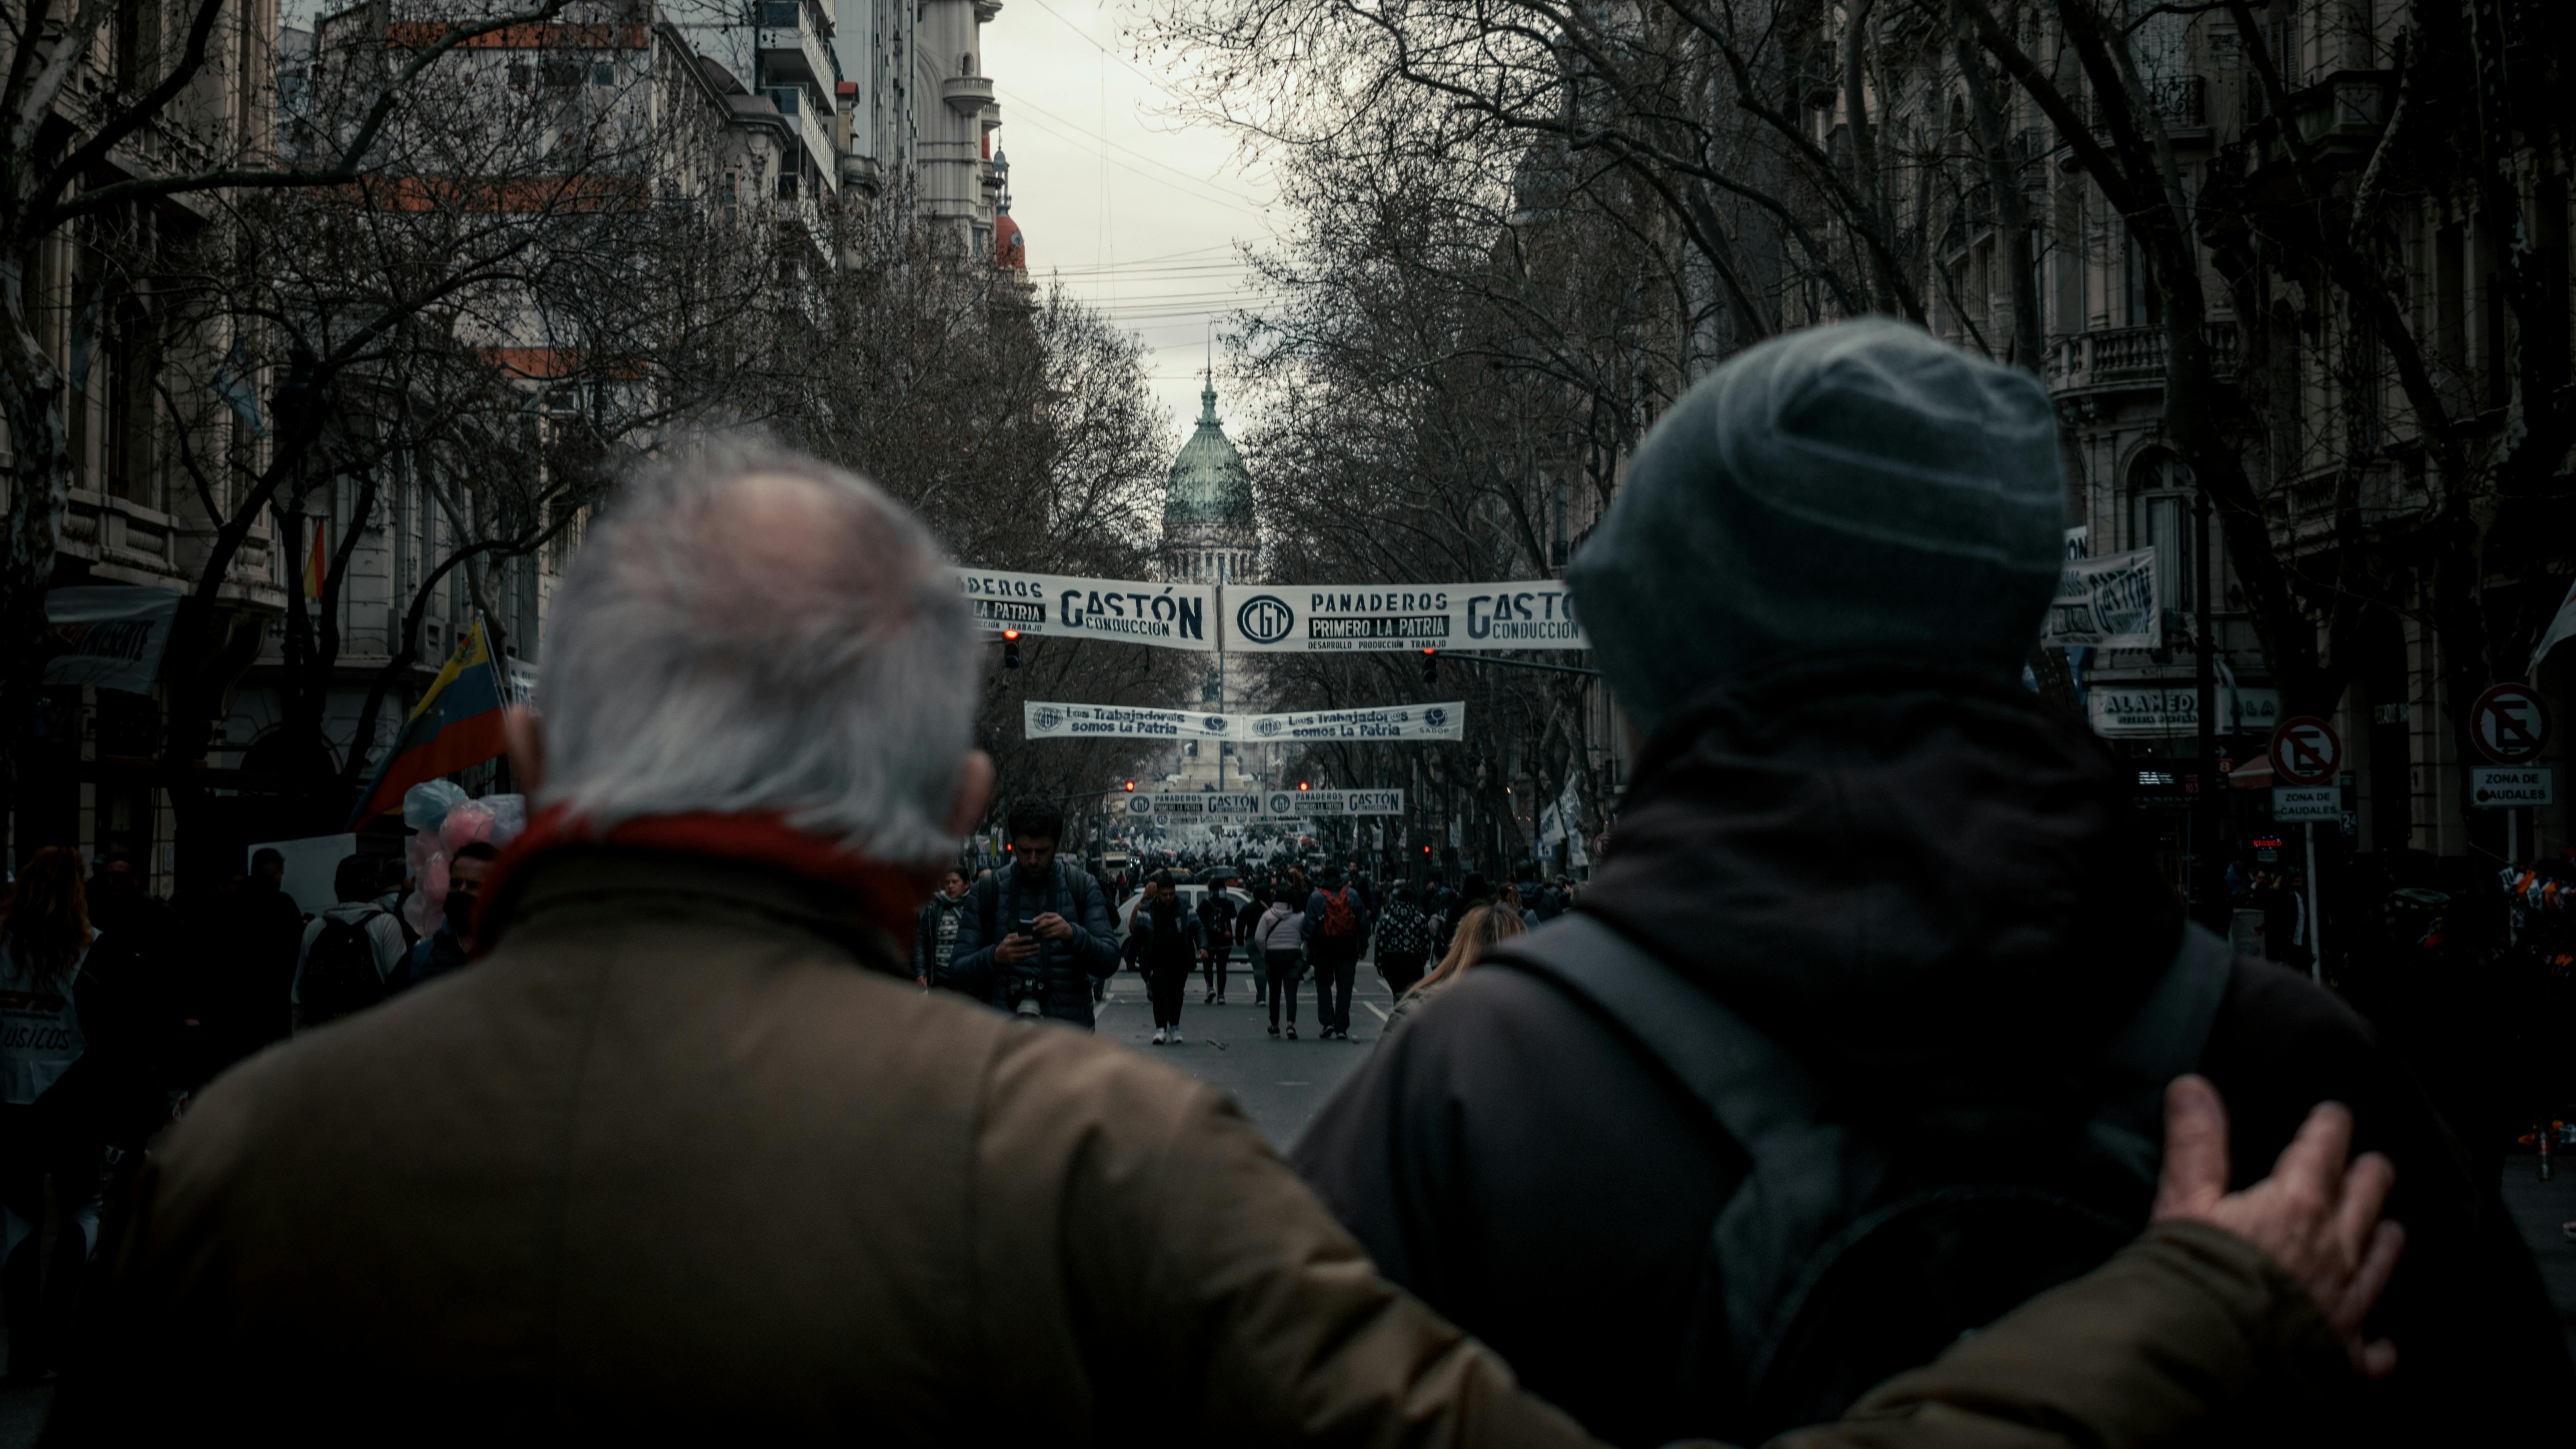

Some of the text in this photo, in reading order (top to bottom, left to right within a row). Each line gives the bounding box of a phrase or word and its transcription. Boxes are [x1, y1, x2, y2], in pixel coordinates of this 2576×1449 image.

[973, 600, 1040, 621] LA PATRIA
[1311, 592, 1447, 613] PANADEROS
[1061, 586, 1204, 640] GASTÓN
[1241, 598, 1290, 641] CGT
[1007, 622, 1042, 632] TRABAJO
[1086, 616, 1170, 637] CONDUCCIÓN
[1312, 618, 1445, 638] PRIMERO LA PATRIA
[1492, 619, 1579, 639] CONDUCCIÓN
[1308, 638, 1446, 650] DESARROLLO PRODUCCIÓN TRABAJO
[2104, 695, 2198, 713] ALAMED
[1072, 722, 1115, 732] somos
[1137, 722, 1177, 734] Patria
[1293, 727, 1336, 737] somos
[1360, 723, 1400, 736] Patria
[2218, 761, 2231, 773] 8
[2486, 774, 2539, 784] ZONA DE
[1208, 793, 1258, 813] GASTÓN
[1295, 792, 1343, 801] PANADEROS
[1349, 790, 1399, 811] GASTÓN
[2285, 792, 2330, 802] ZONA DE
[2281, 806, 2337, 815] CAUDALES
[2342, 814, 2358, 829] 24
